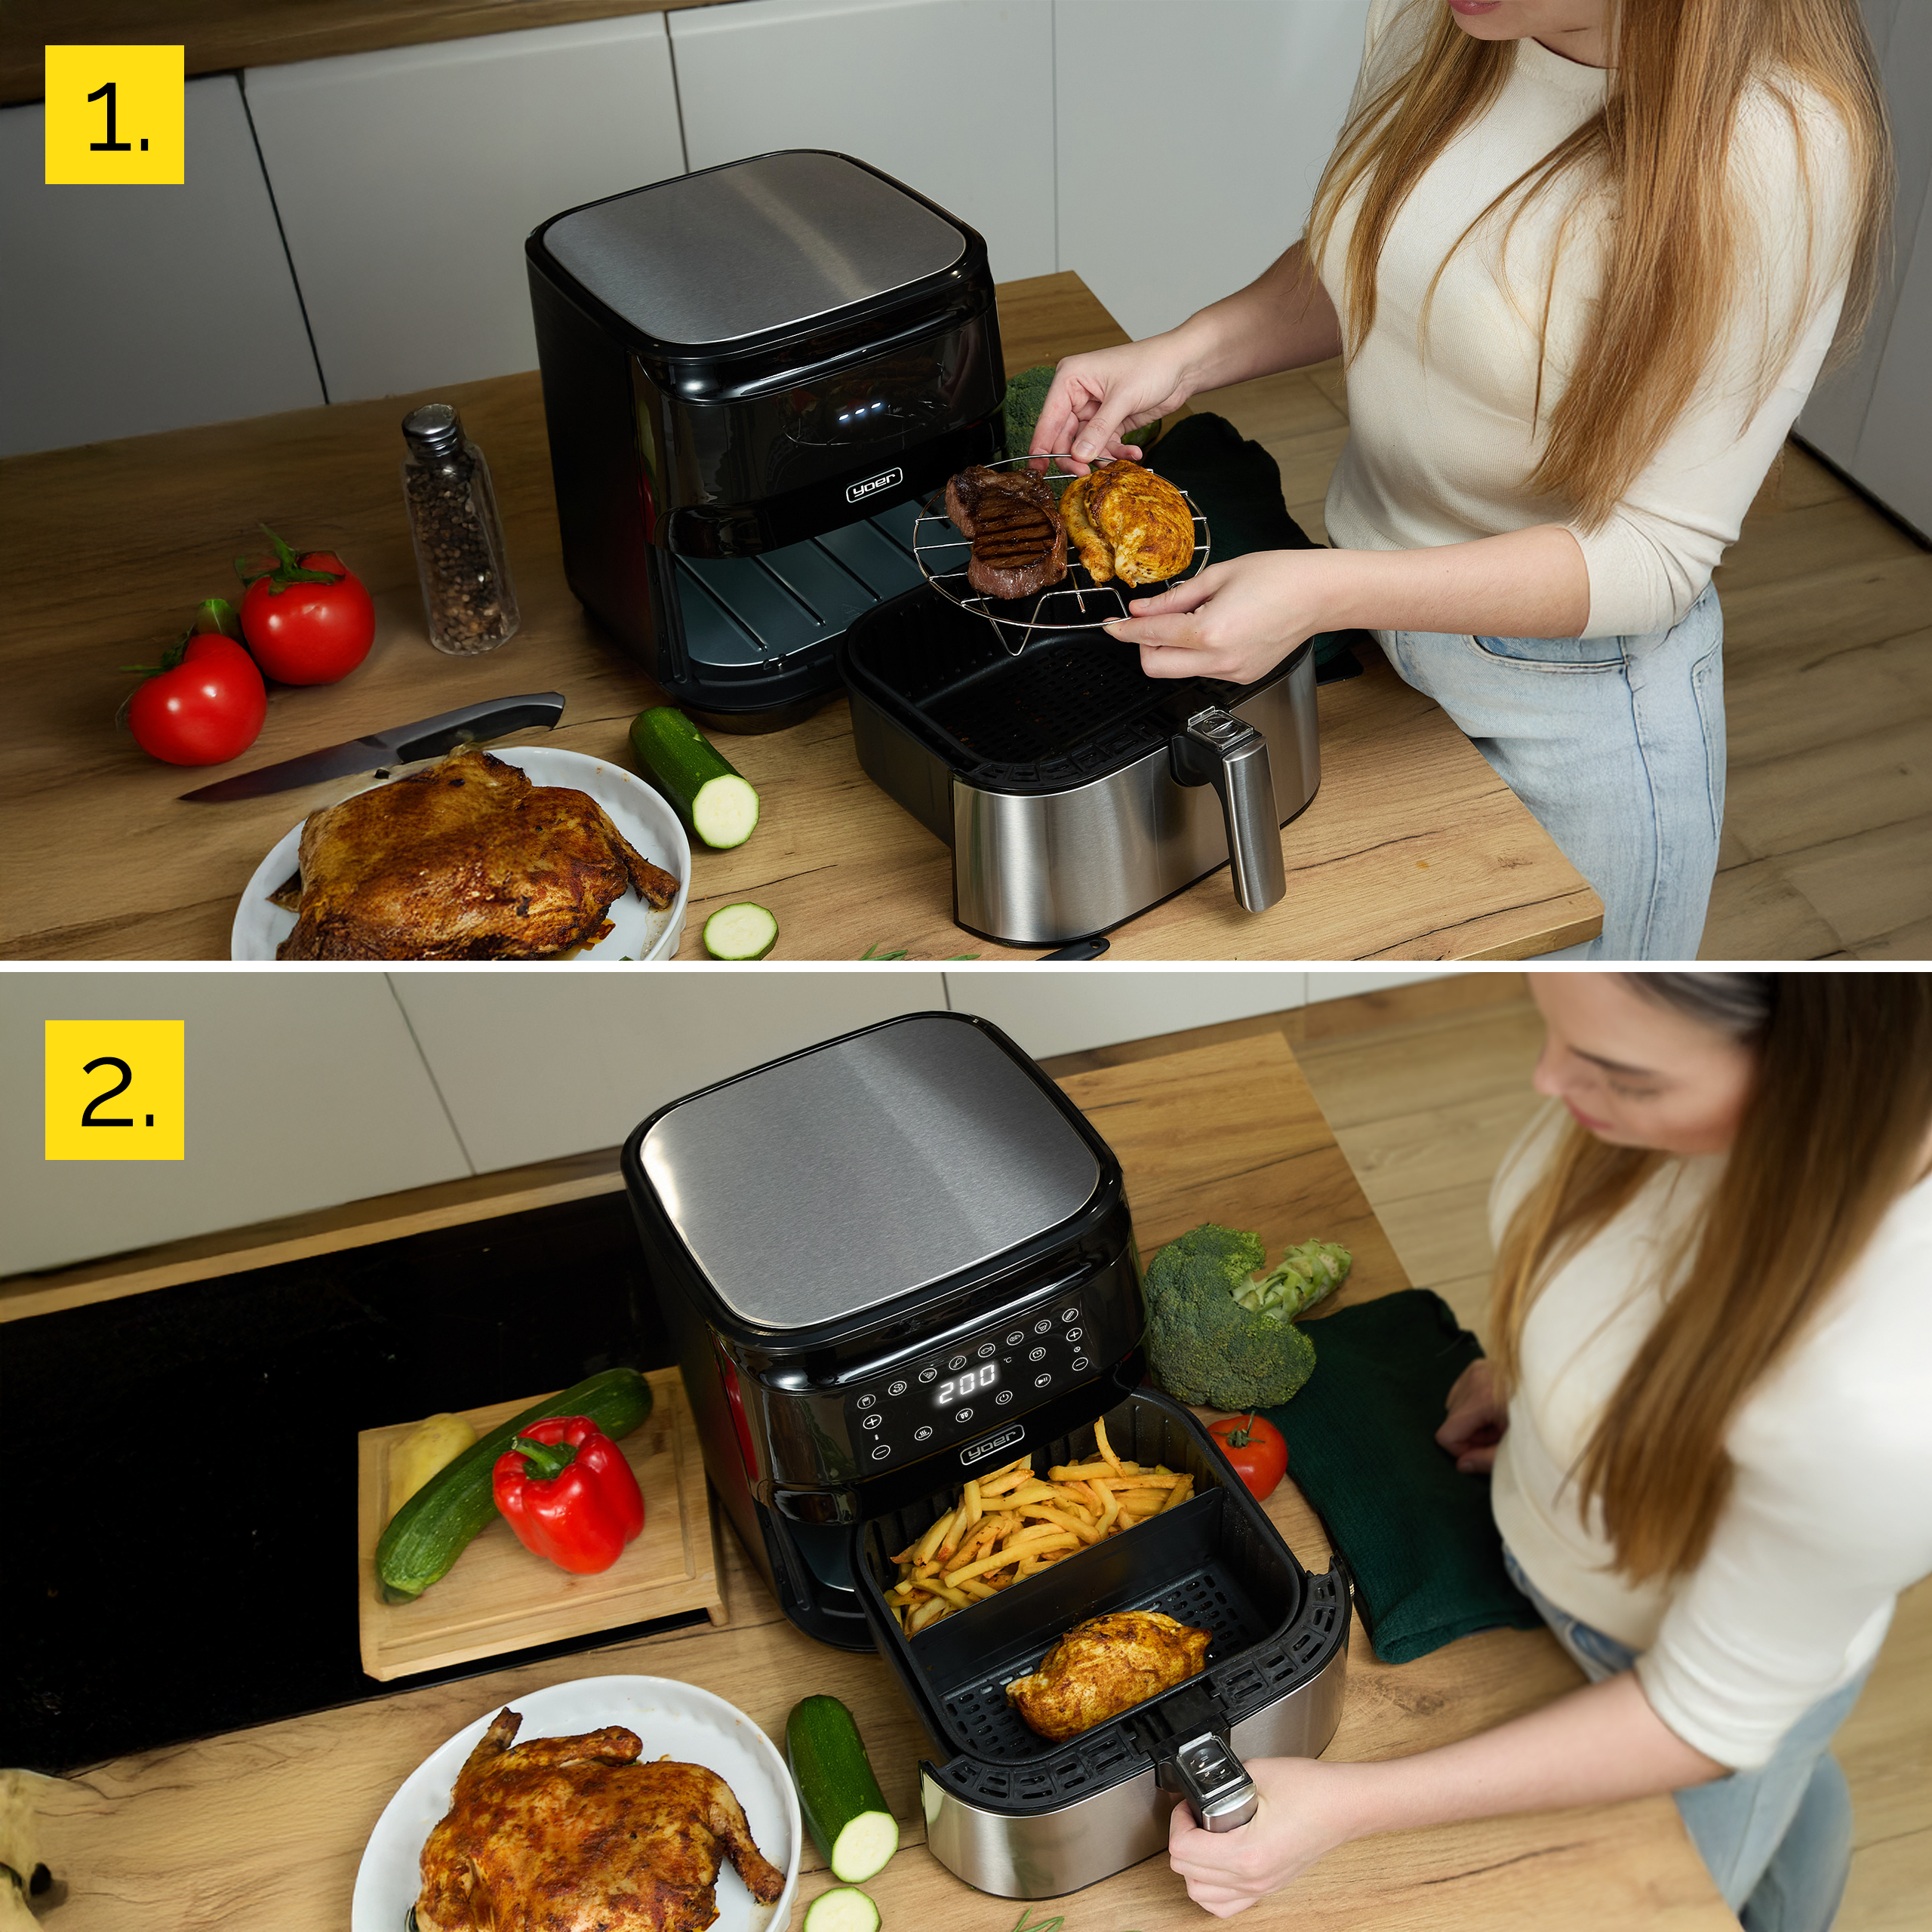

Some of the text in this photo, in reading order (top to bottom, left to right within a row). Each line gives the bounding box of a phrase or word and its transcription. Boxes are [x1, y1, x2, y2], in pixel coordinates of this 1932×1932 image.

[853, 473, 896, 497] yoer
[939, 1363, 995, 1404] 200
[967, 1431, 1017, 1460] yoer
